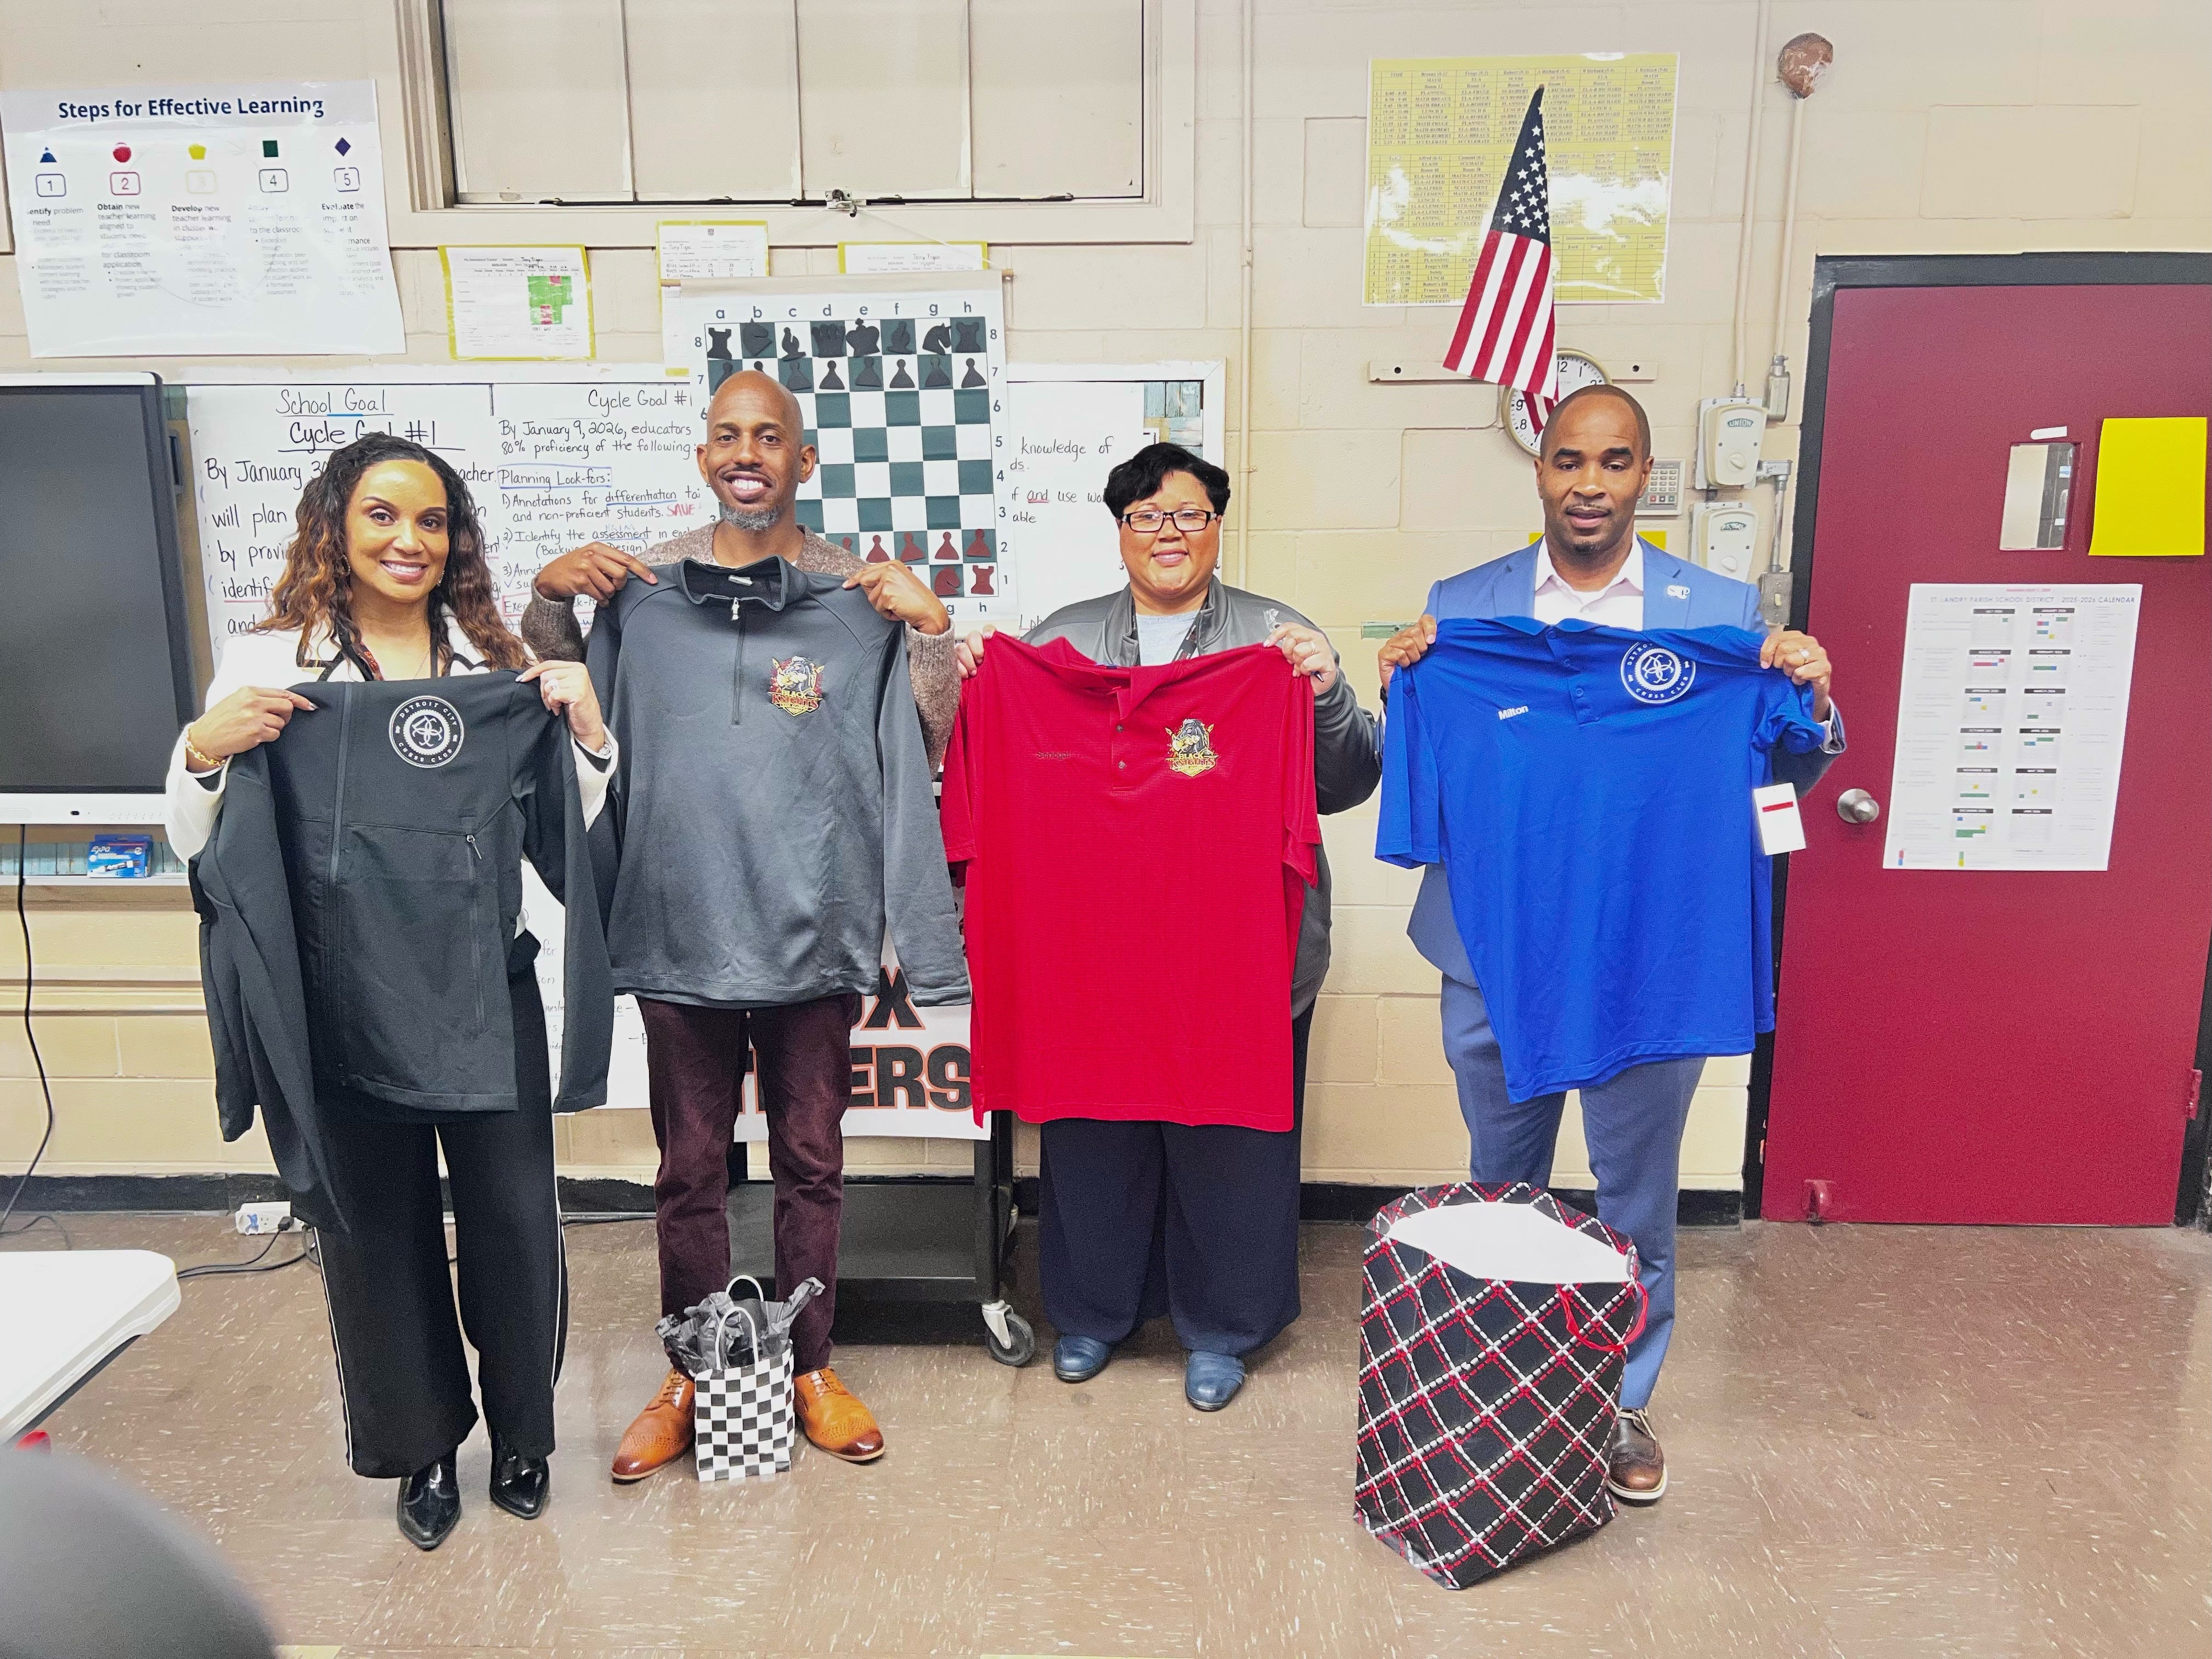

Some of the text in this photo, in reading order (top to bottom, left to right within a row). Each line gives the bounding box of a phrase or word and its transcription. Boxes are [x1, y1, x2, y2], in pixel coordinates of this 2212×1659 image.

[59, 96, 325, 122] Steps for Effective Learning
[47, 179, 53, 191] 1
[121, 178, 130, 190] 2
[269, 174, 278, 187] 4
[343, 173, 352, 187] 5
[26, 207, 83, 216] entify problem
[172, 205, 202, 213] Develop
[99, 223, 125, 231] aligned
[715, 301, 972, 319] a b c d e f g h
[695, 336, 702, 348] 8
[990, 329, 997, 340] 8
[992, 367, 998, 377] 7
[1558, 361, 1567, 373] 12
[1579, 366, 1582, 377] 1
[697, 374, 704, 385] 7
[275, 387, 385, 415] School Goal
[588, 389, 693, 417] Cycle Goal #1
[993, 399, 1001, 412] 6
[1516, 399, 1523, 411] 9
[701, 407, 707, 420] 6
[498, 419, 516, 438] By
[522, 421, 569, 442] January
[588, 422, 627, 440] 2026,
[631, 420, 692, 435] educators
[1520, 419, 1527, 430] 8
[290, 419, 435, 454] Cycle Gl #1
[995, 436, 1002, 447] 5
[501, 439, 526, 455] 80%
[534, 439, 589, 459] proficiency
[596, 439, 606, 452] of
[612, 438, 632, 451] the
[1020, 436, 1114, 462] knowledge of
[205, 457, 228, 489] By
[235, 460, 302, 490] January
[453, 461, 495, 482] acher
[996, 470, 1005, 481] 4
[498, 468, 611, 493] Planning Look-fors:
[512, 492, 572, 507] Annotations
[582, 490, 599, 504] for
[605, 488, 677, 503] differentiation
[1027, 489, 1048, 501] and
[1058, 491, 1077, 503] use
[512, 503, 695, 522] and non-proficient students. SAVE
[998, 507, 1006, 518] 3
[1013, 511, 1037, 523] able
[212, 503, 287, 538] will plan
[515, 529, 560, 545] Identify
[566, 529, 585, 540] the
[592, 526, 652, 539] assessment
[658, 530, 667, 539] in
[672, 527, 690, 538] eac
[535, 543, 579, 560] (Backw
[1001, 541, 1008, 552] 2
[217, 539, 286, 572] by provi
[514, 563, 544, 576] Annot
[1003, 574, 1008, 584] 1
[221, 577, 274, 599] identif
[947, 602, 987, 615] g h
[227, 614, 257, 635] and
[1627, 643, 1652, 665] DETRO
[1635, 688, 1665, 698] CHESS
[1671, 676, 1689, 695] CLUB
[772, 693, 819, 708] KNIGHTS
[399, 701, 439, 718] DETROIT
[443, 708, 457, 726] CITY
[1498, 704, 1529, 720] Milton
[398, 742, 425, 762] CHESS
[431, 748, 453, 763] CLUB
[1171, 757, 1215, 766] KNIGHTS
[541, 939, 557, 956] for
[848, 1043, 973, 1111] ERS
